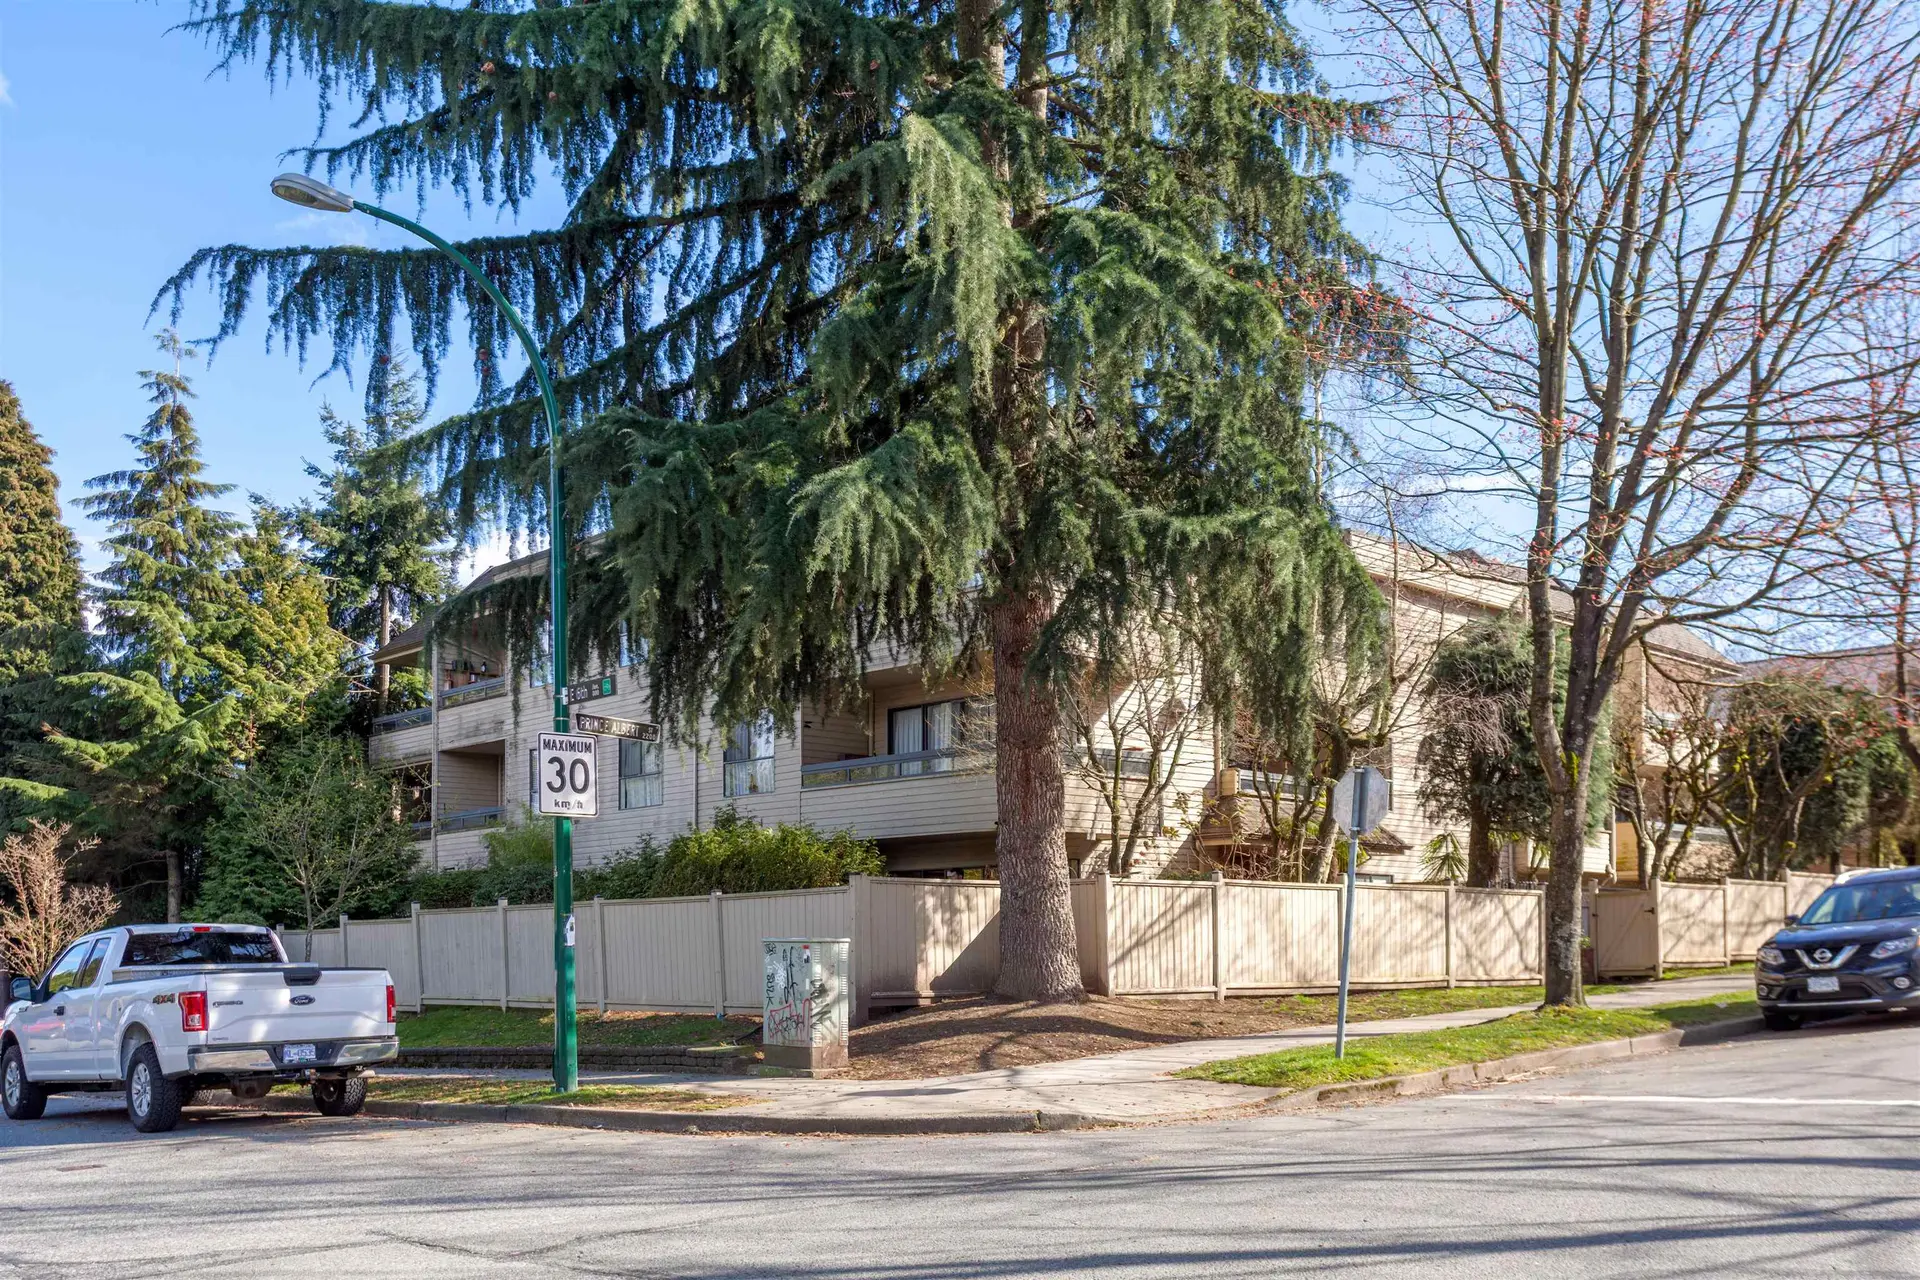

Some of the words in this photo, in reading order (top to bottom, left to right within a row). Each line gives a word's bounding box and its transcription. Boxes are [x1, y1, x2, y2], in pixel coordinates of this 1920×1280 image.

[570, 688, 575, 701] E
[580, 716, 609, 733] PRINCE
[611, 720, 640, 737] ALBERT
[542, 738, 593, 754] MAXIMUM
[546, 755, 591, 795] 30
[554, 798, 584, 810] km/h
